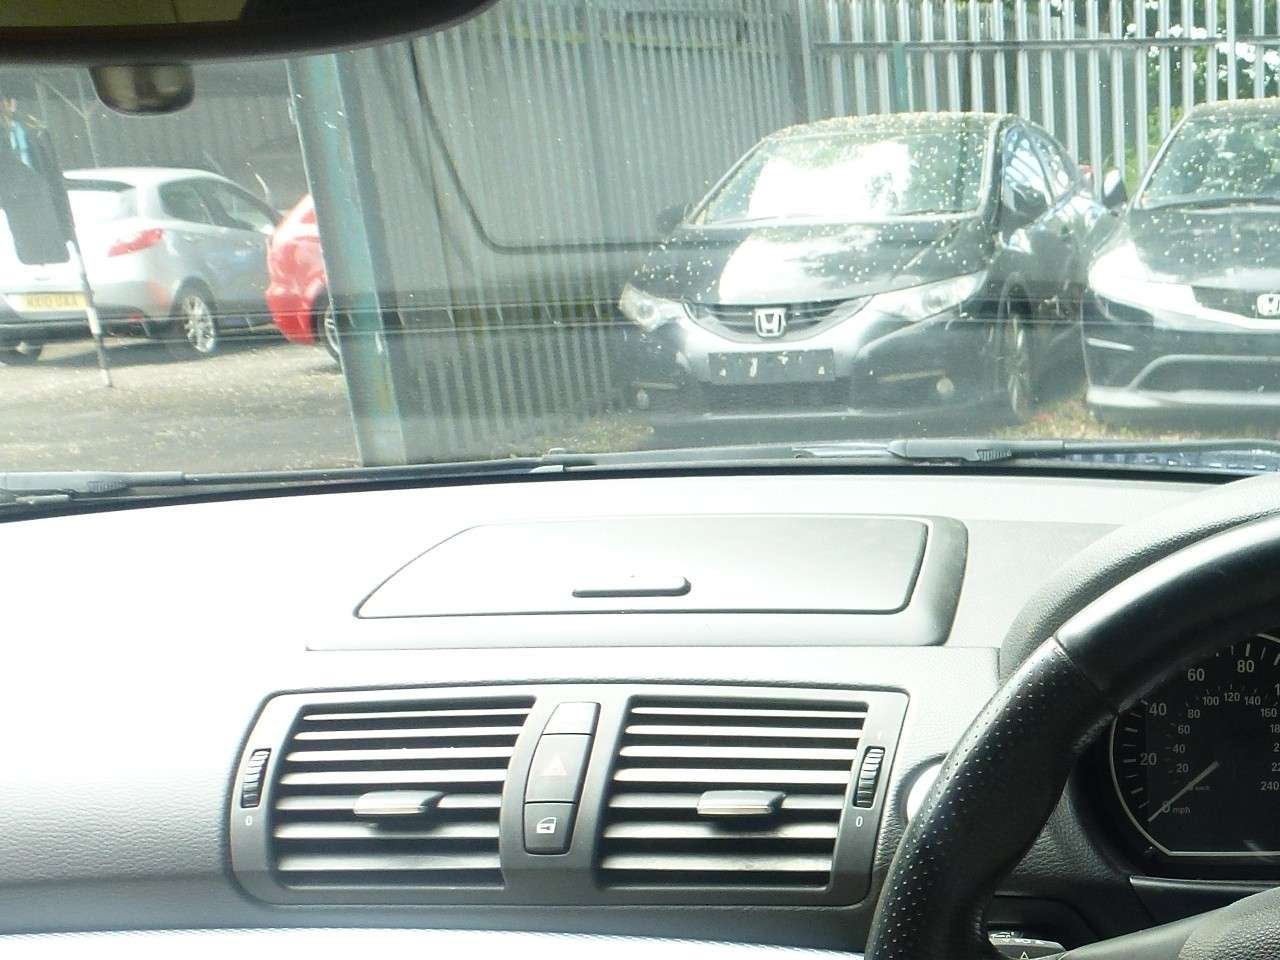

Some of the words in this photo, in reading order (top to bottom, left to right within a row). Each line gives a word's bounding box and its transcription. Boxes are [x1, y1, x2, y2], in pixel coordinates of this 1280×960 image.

[1236, 659, 1255, 673] 80
[1187, 668, 1205, 682] 60
[1203, 695, 1220, 706] 100
[1223, 692, 1241, 703] 120
[1244, 695, 1261, 706] 140
[1149, 703, 1167, 716] 40
[1187, 709, 1200, 719] 80
[1260, 707, 1278, 718] 160
[1177, 724, 1191, 735] 60
[1173, 744, 1186, 754] 40
[1140, 753, 1157, 766] 20
[1176, 763, 1189, 773] 20
[1260, 781, 1280, 791] 240
[1173, 805, 1191, 815] mph
